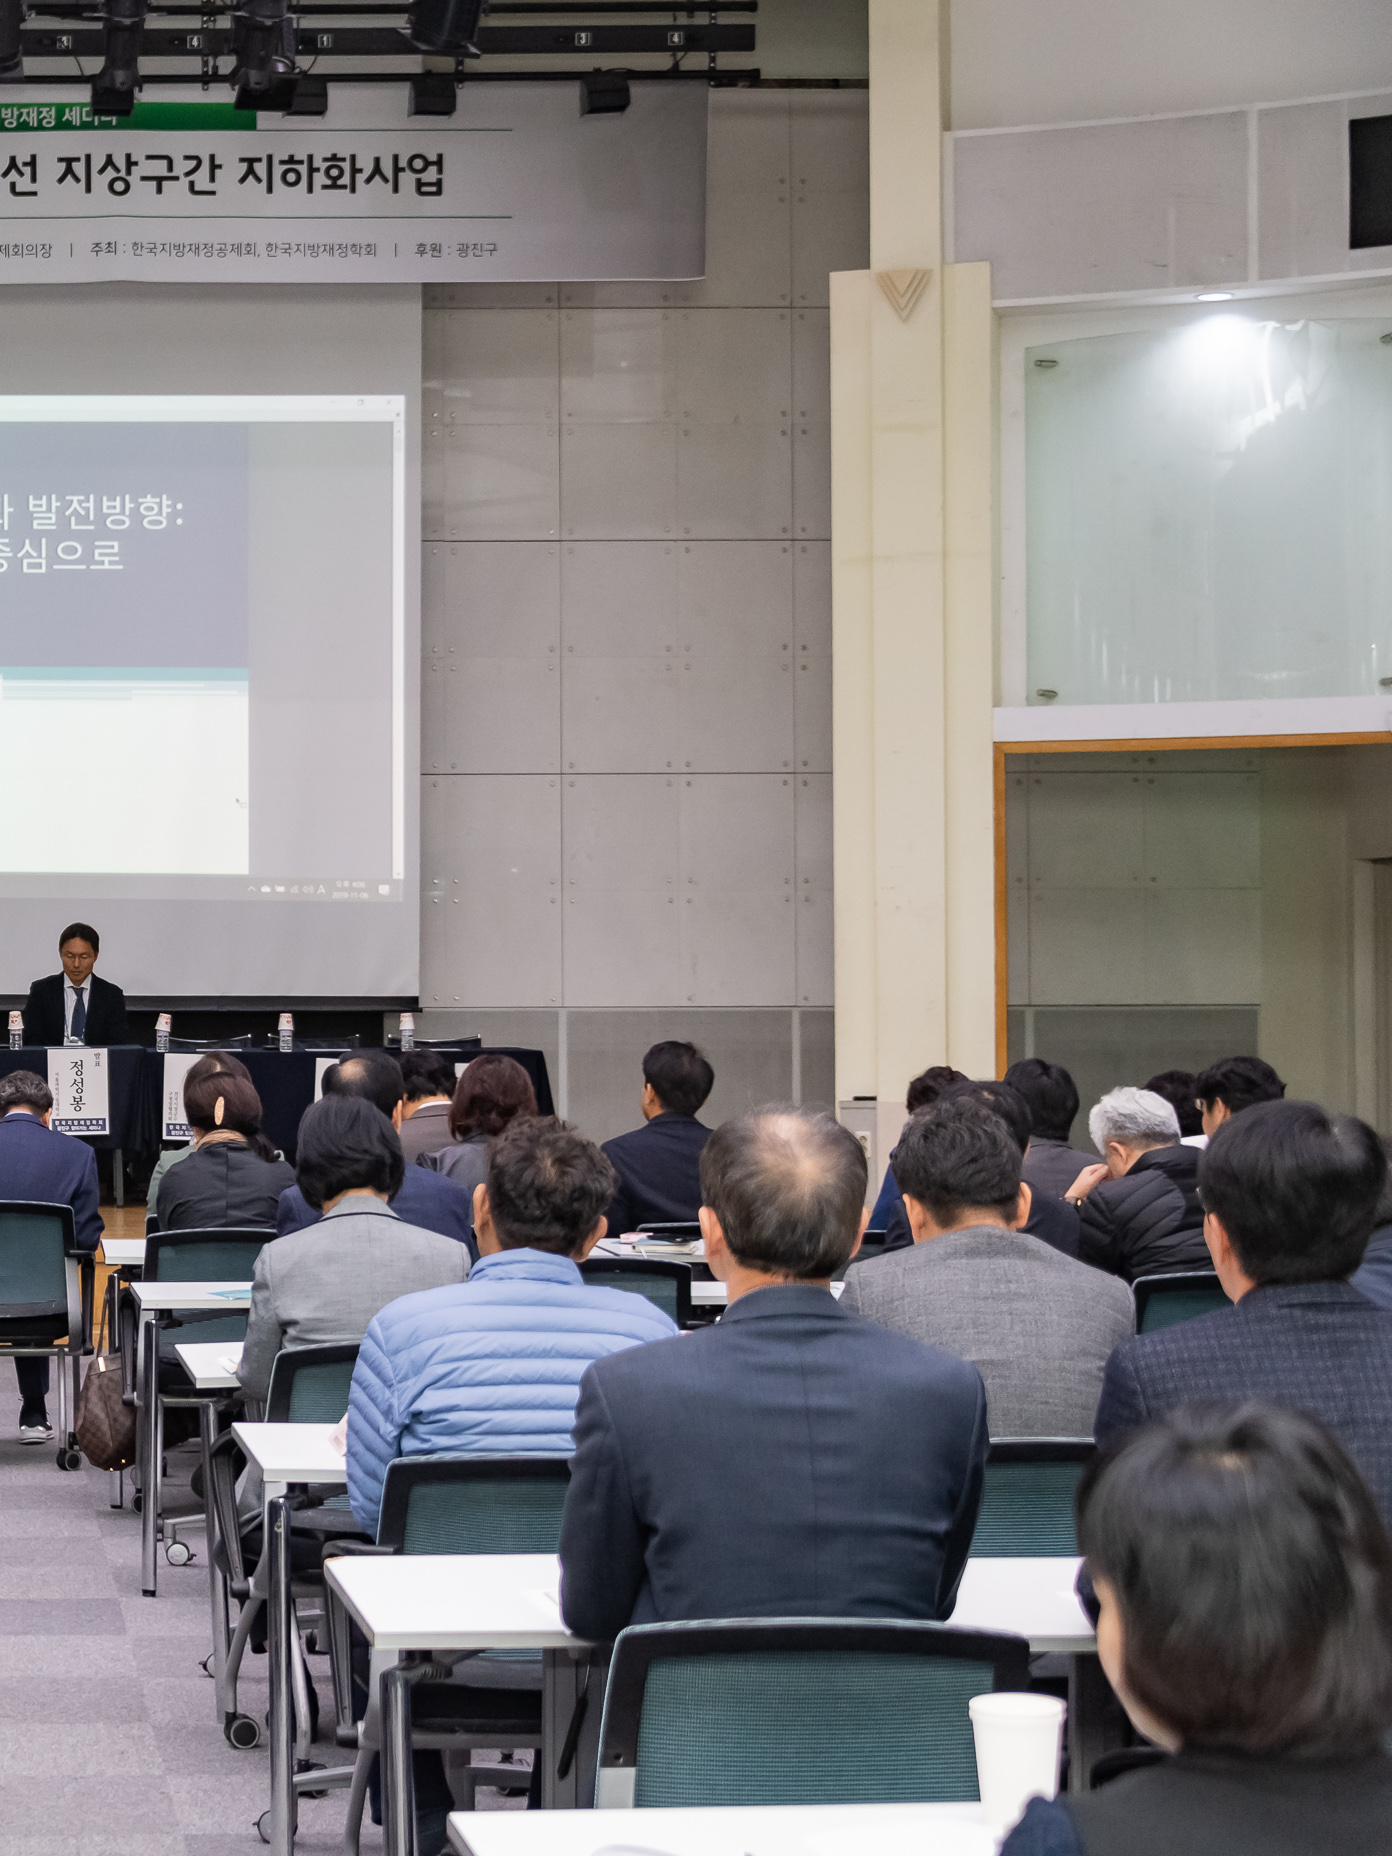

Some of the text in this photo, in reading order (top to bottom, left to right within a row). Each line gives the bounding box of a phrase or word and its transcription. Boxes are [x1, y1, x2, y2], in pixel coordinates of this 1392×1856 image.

[56, 152, 223, 197] 지상구간
[237, 152, 446, 197] 지하화사업
[90, 241, 117, 257] 주최
[131, 242, 261, 258] 한국지방재정공제회,
[265, 242, 377, 258] 한국지방재정학회
[415, 242, 442, 258] 후원
[455, 242, 498, 258] 광진구
[28, 493, 185, 531] 발전방향:
[94, 1052, 101, 1067] 발표
[69, 1059, 86, 1112] 정성봉
